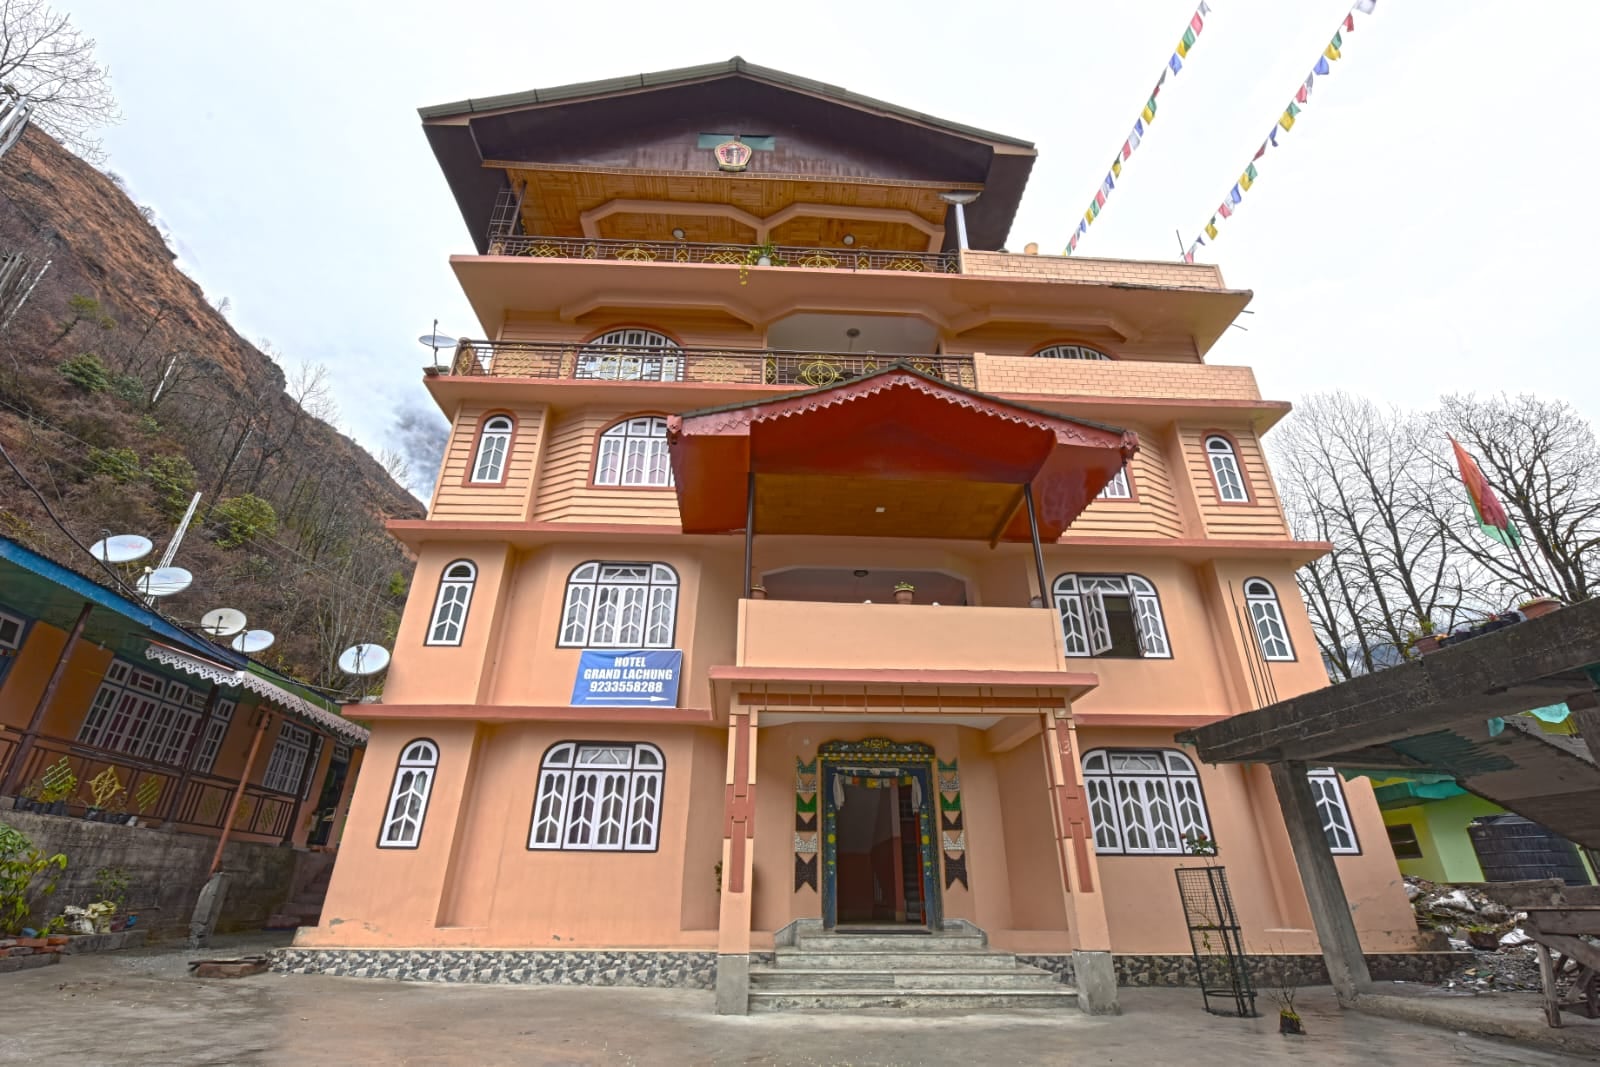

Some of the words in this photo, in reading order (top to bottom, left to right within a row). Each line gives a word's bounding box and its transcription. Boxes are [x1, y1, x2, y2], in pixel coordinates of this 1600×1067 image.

[614, 656, 646, 667] HOTEL
[584, 669, 621, 680] GRAND
[622, 669, 673, 680] LACHUNG
